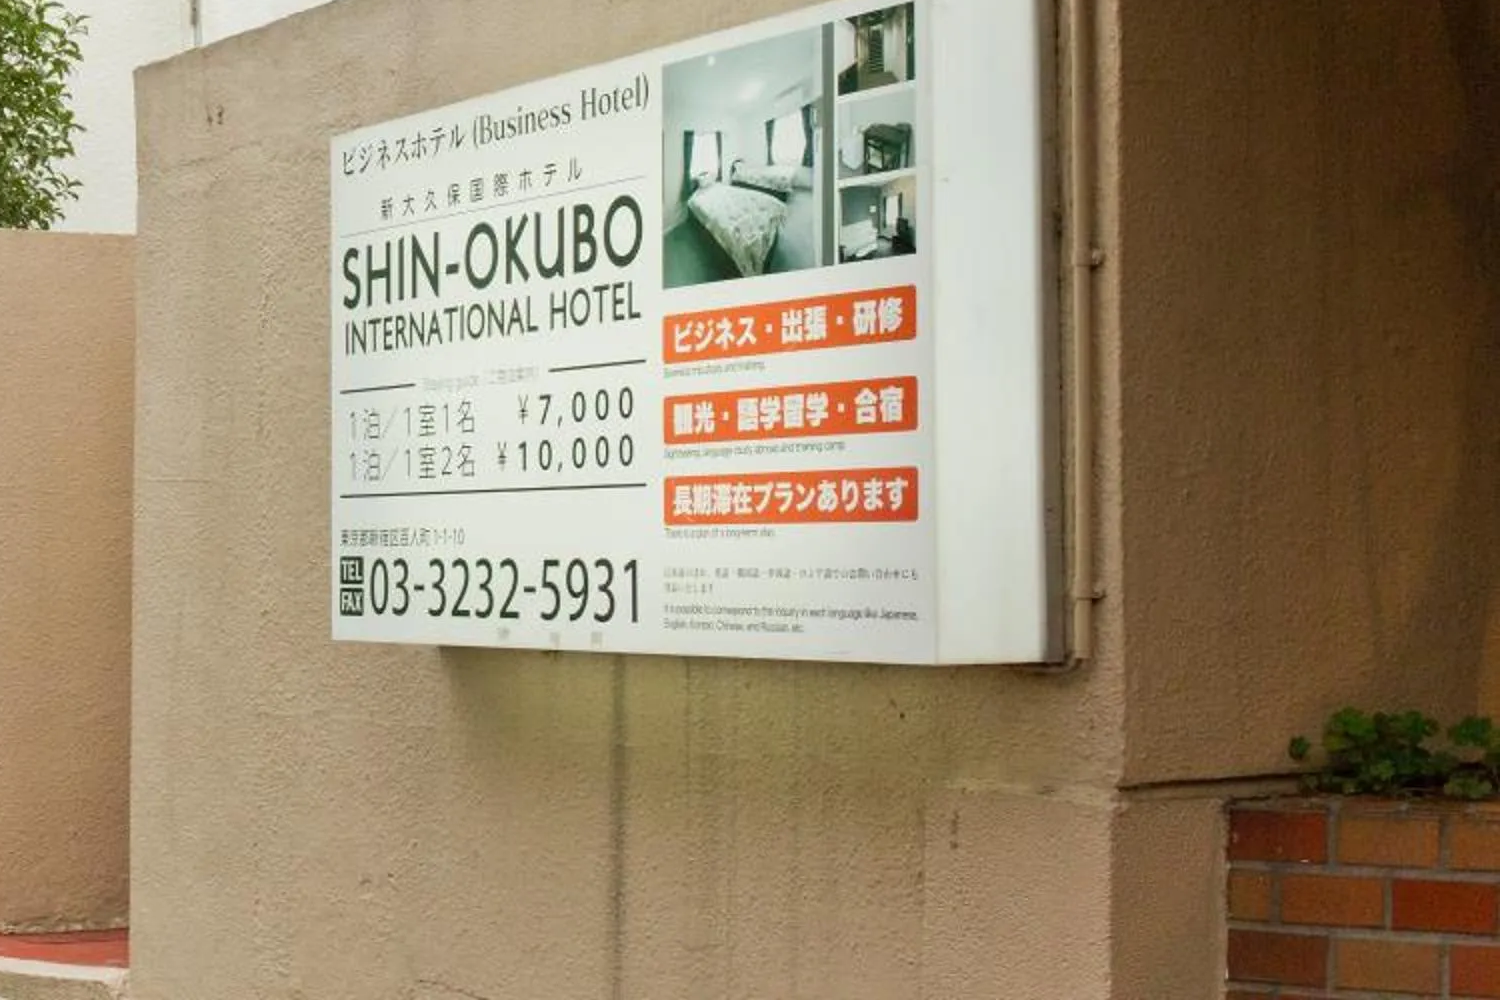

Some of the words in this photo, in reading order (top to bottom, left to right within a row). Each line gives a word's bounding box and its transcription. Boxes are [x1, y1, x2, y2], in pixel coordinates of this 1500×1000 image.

[343, 124, 466, 178] ビジネスホテル
[472, 101, 573, 149] (Business
[580, 71, 651, 122] Hotel)
[381, 157, 584, 222] 新大久保国際ホテル
[342, 193, 644, 311] SHIN-OKUBO
[344, 295, 539, 356] INTERNATIONAL
[550, 280, 642, 331] HOTEL
[673, 296, 904, 354] ビジネス・出張・研修
[672, 476, 909, 517] 長期滞在プランあります
[340, 559, 363, 582] TEL
[370, 556, 639, 624] 03-3232-5931
[340, 591, 363, 612] FAX
